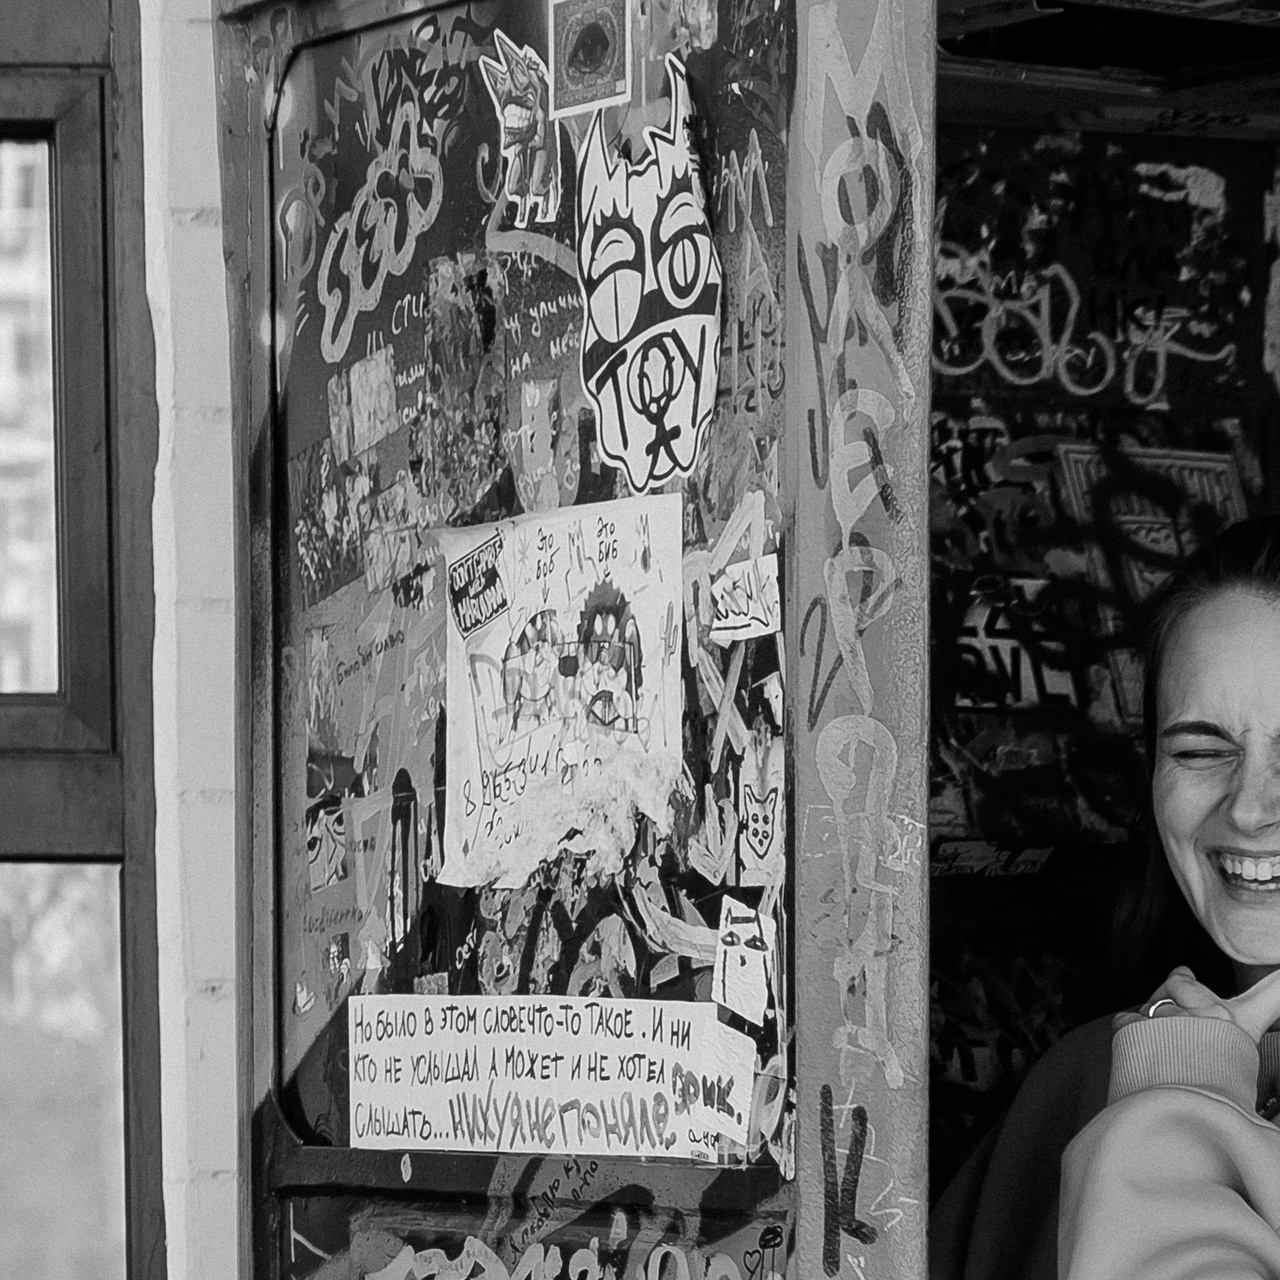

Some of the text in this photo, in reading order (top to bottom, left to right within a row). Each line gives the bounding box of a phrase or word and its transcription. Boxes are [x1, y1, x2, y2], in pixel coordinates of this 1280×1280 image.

[440, 1003, 478, 1036] ЭТОМ
[353, 1052, 378, 1084] КТО
[384, 1055, 403, 1083] НЕ
[410, 1045, 480, 1087] УСЛЫШАЛ
[504, 1045, 565, 1081] МОЖЕТ
[588, 1051, 611, 1083] НЕ
[618, 1053, 666, 1084] ХОТЕЛ
